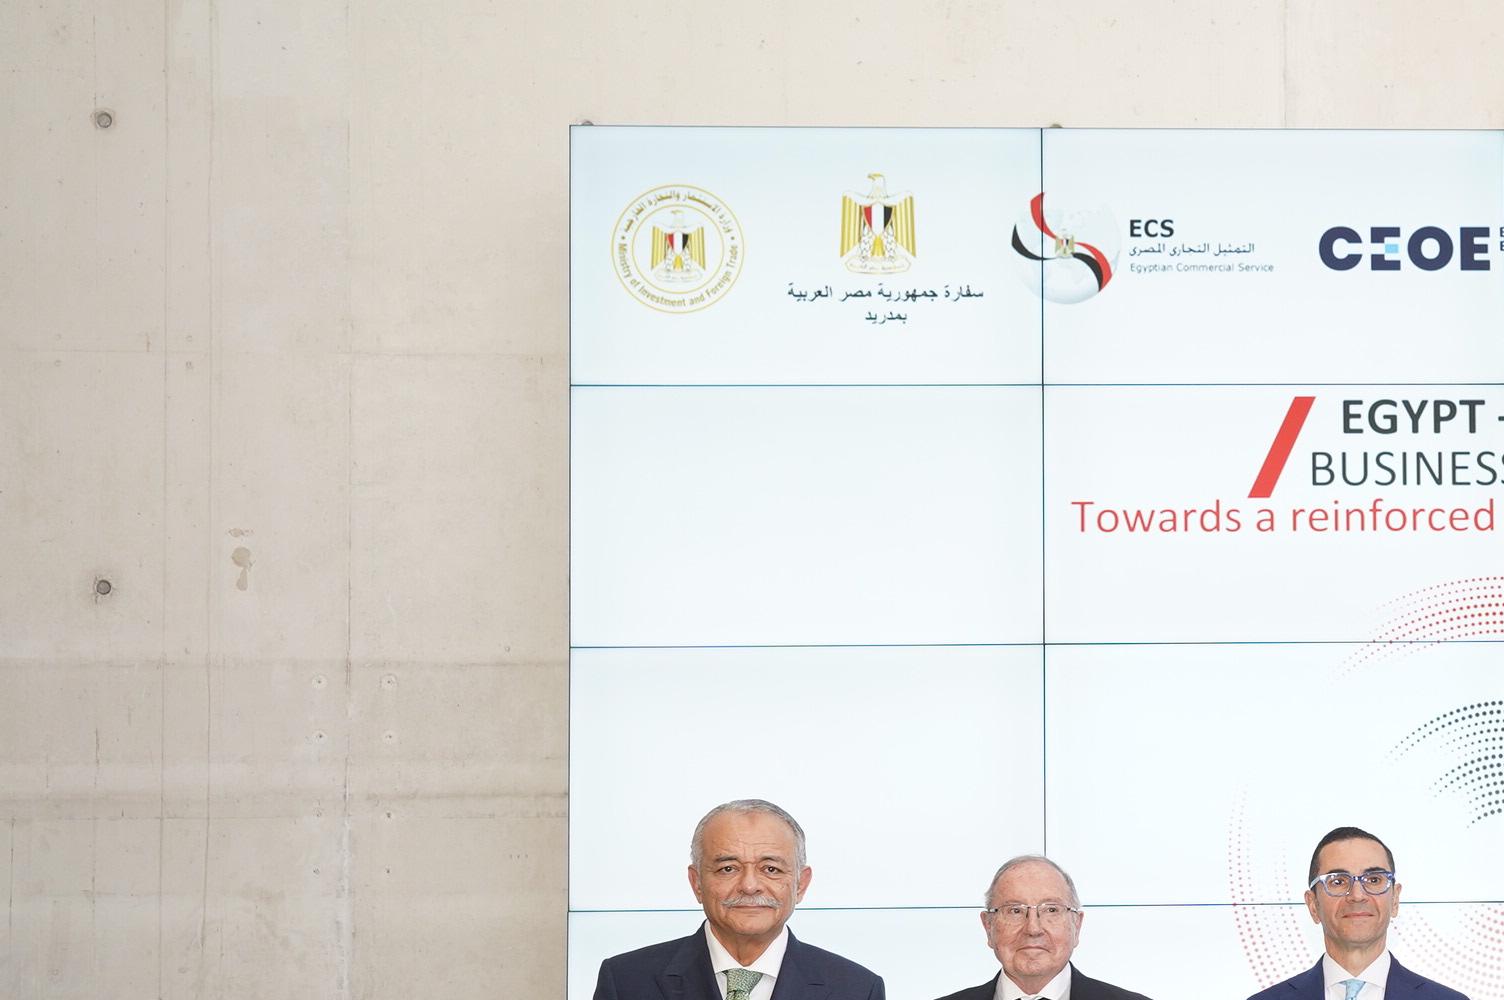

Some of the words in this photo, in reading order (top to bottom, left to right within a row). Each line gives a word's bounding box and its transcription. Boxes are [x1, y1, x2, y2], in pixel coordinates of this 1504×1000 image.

[1129, 218, 1175, 238] ECS
[1318, 226, 1491, 271] CEOE
[1130, 262, 1173, 274] Egyptian
[1176, 262, 1235, 272] Commercial
[1237, 262, 1275, 272] Service
[787, 282, 833, 302] العربية
[840, 288, 873, 302] مصر
[877, 282, 939, 302] جمهورية
[944, 284, 985, 302] سفارة
[865, 310, 908, 325] بمدريد
[1341, 398, 1487, 435] EGYPT
[1071, 499, 1242, 533] Towards
[1255, 507, 1276, 533] a
[1291, 498, 1496, 533] reinforced
